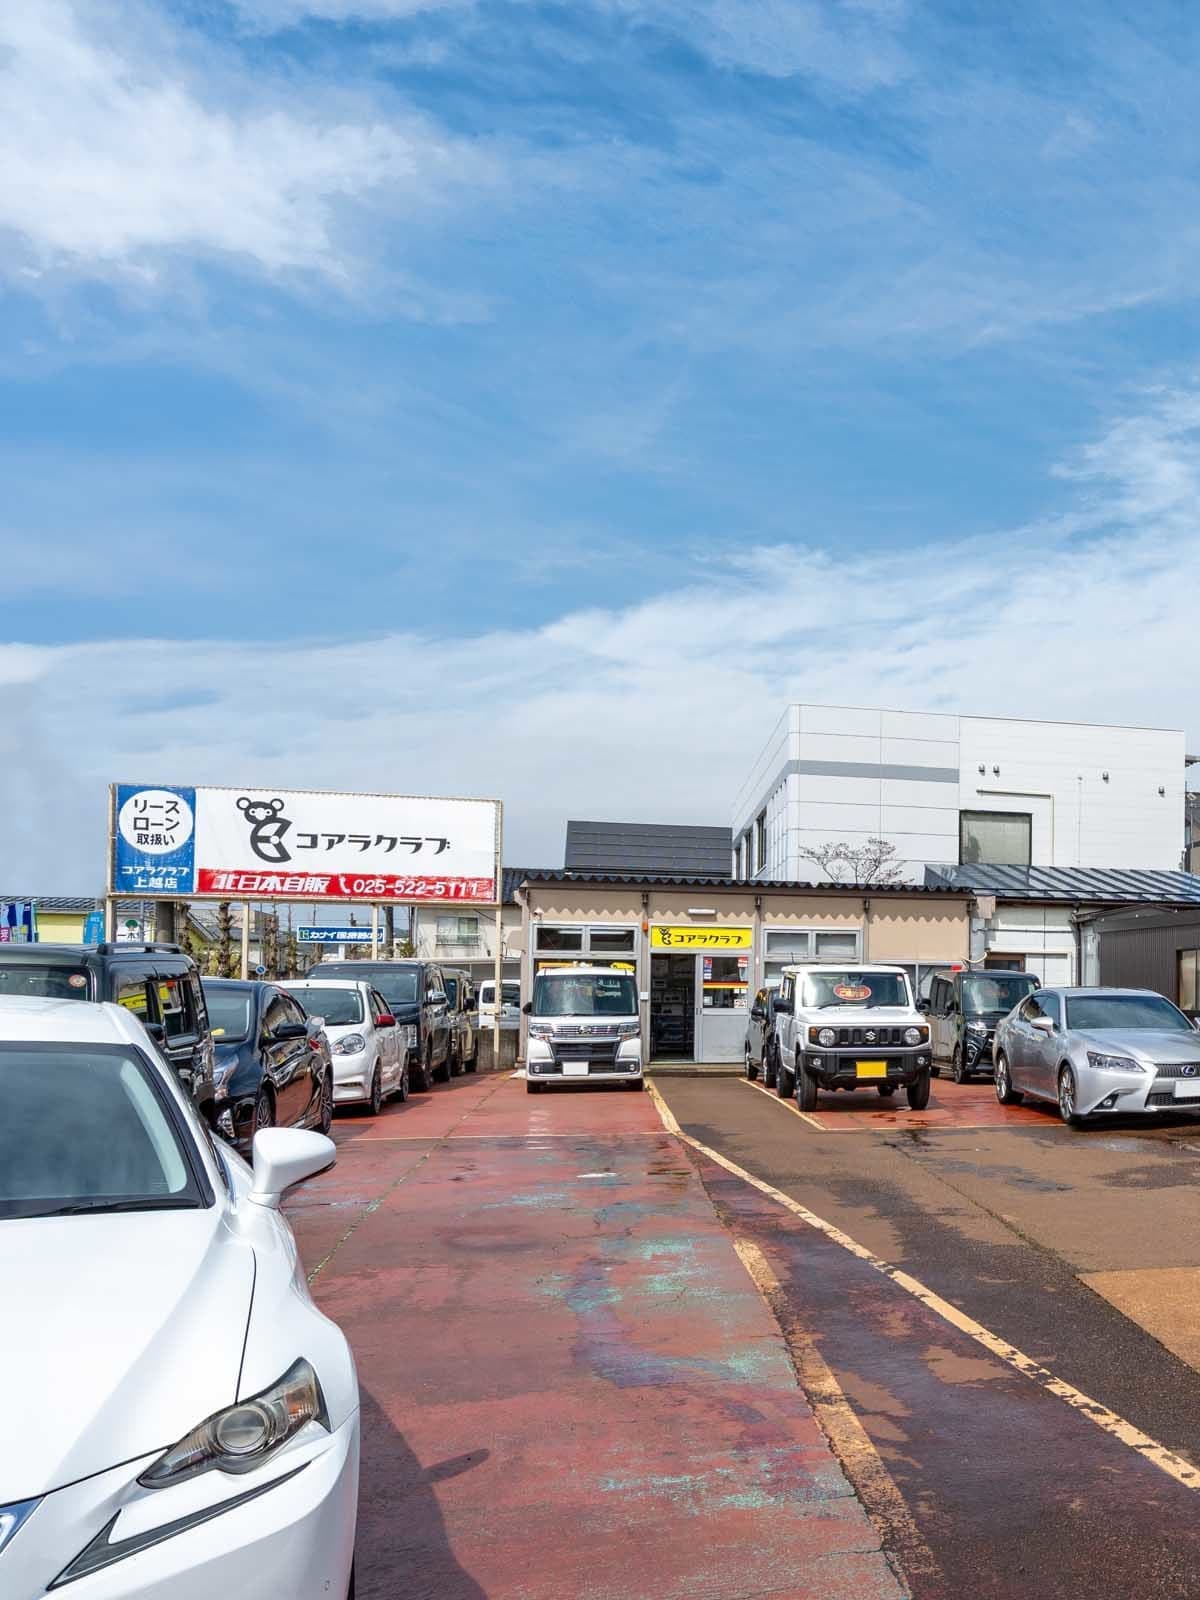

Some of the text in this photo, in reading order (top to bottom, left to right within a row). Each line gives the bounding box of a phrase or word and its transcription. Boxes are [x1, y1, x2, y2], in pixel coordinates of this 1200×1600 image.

[134, 799, 180, 815] リース
[133, 816, 180, 832] ローン
[136, 832, 176, 846] 取扱い
[296, 833, 450, 855] コアラクラブ
[133, 876, 178, 889] 上越店
[212, 874, 330, 893] 北日本自販
